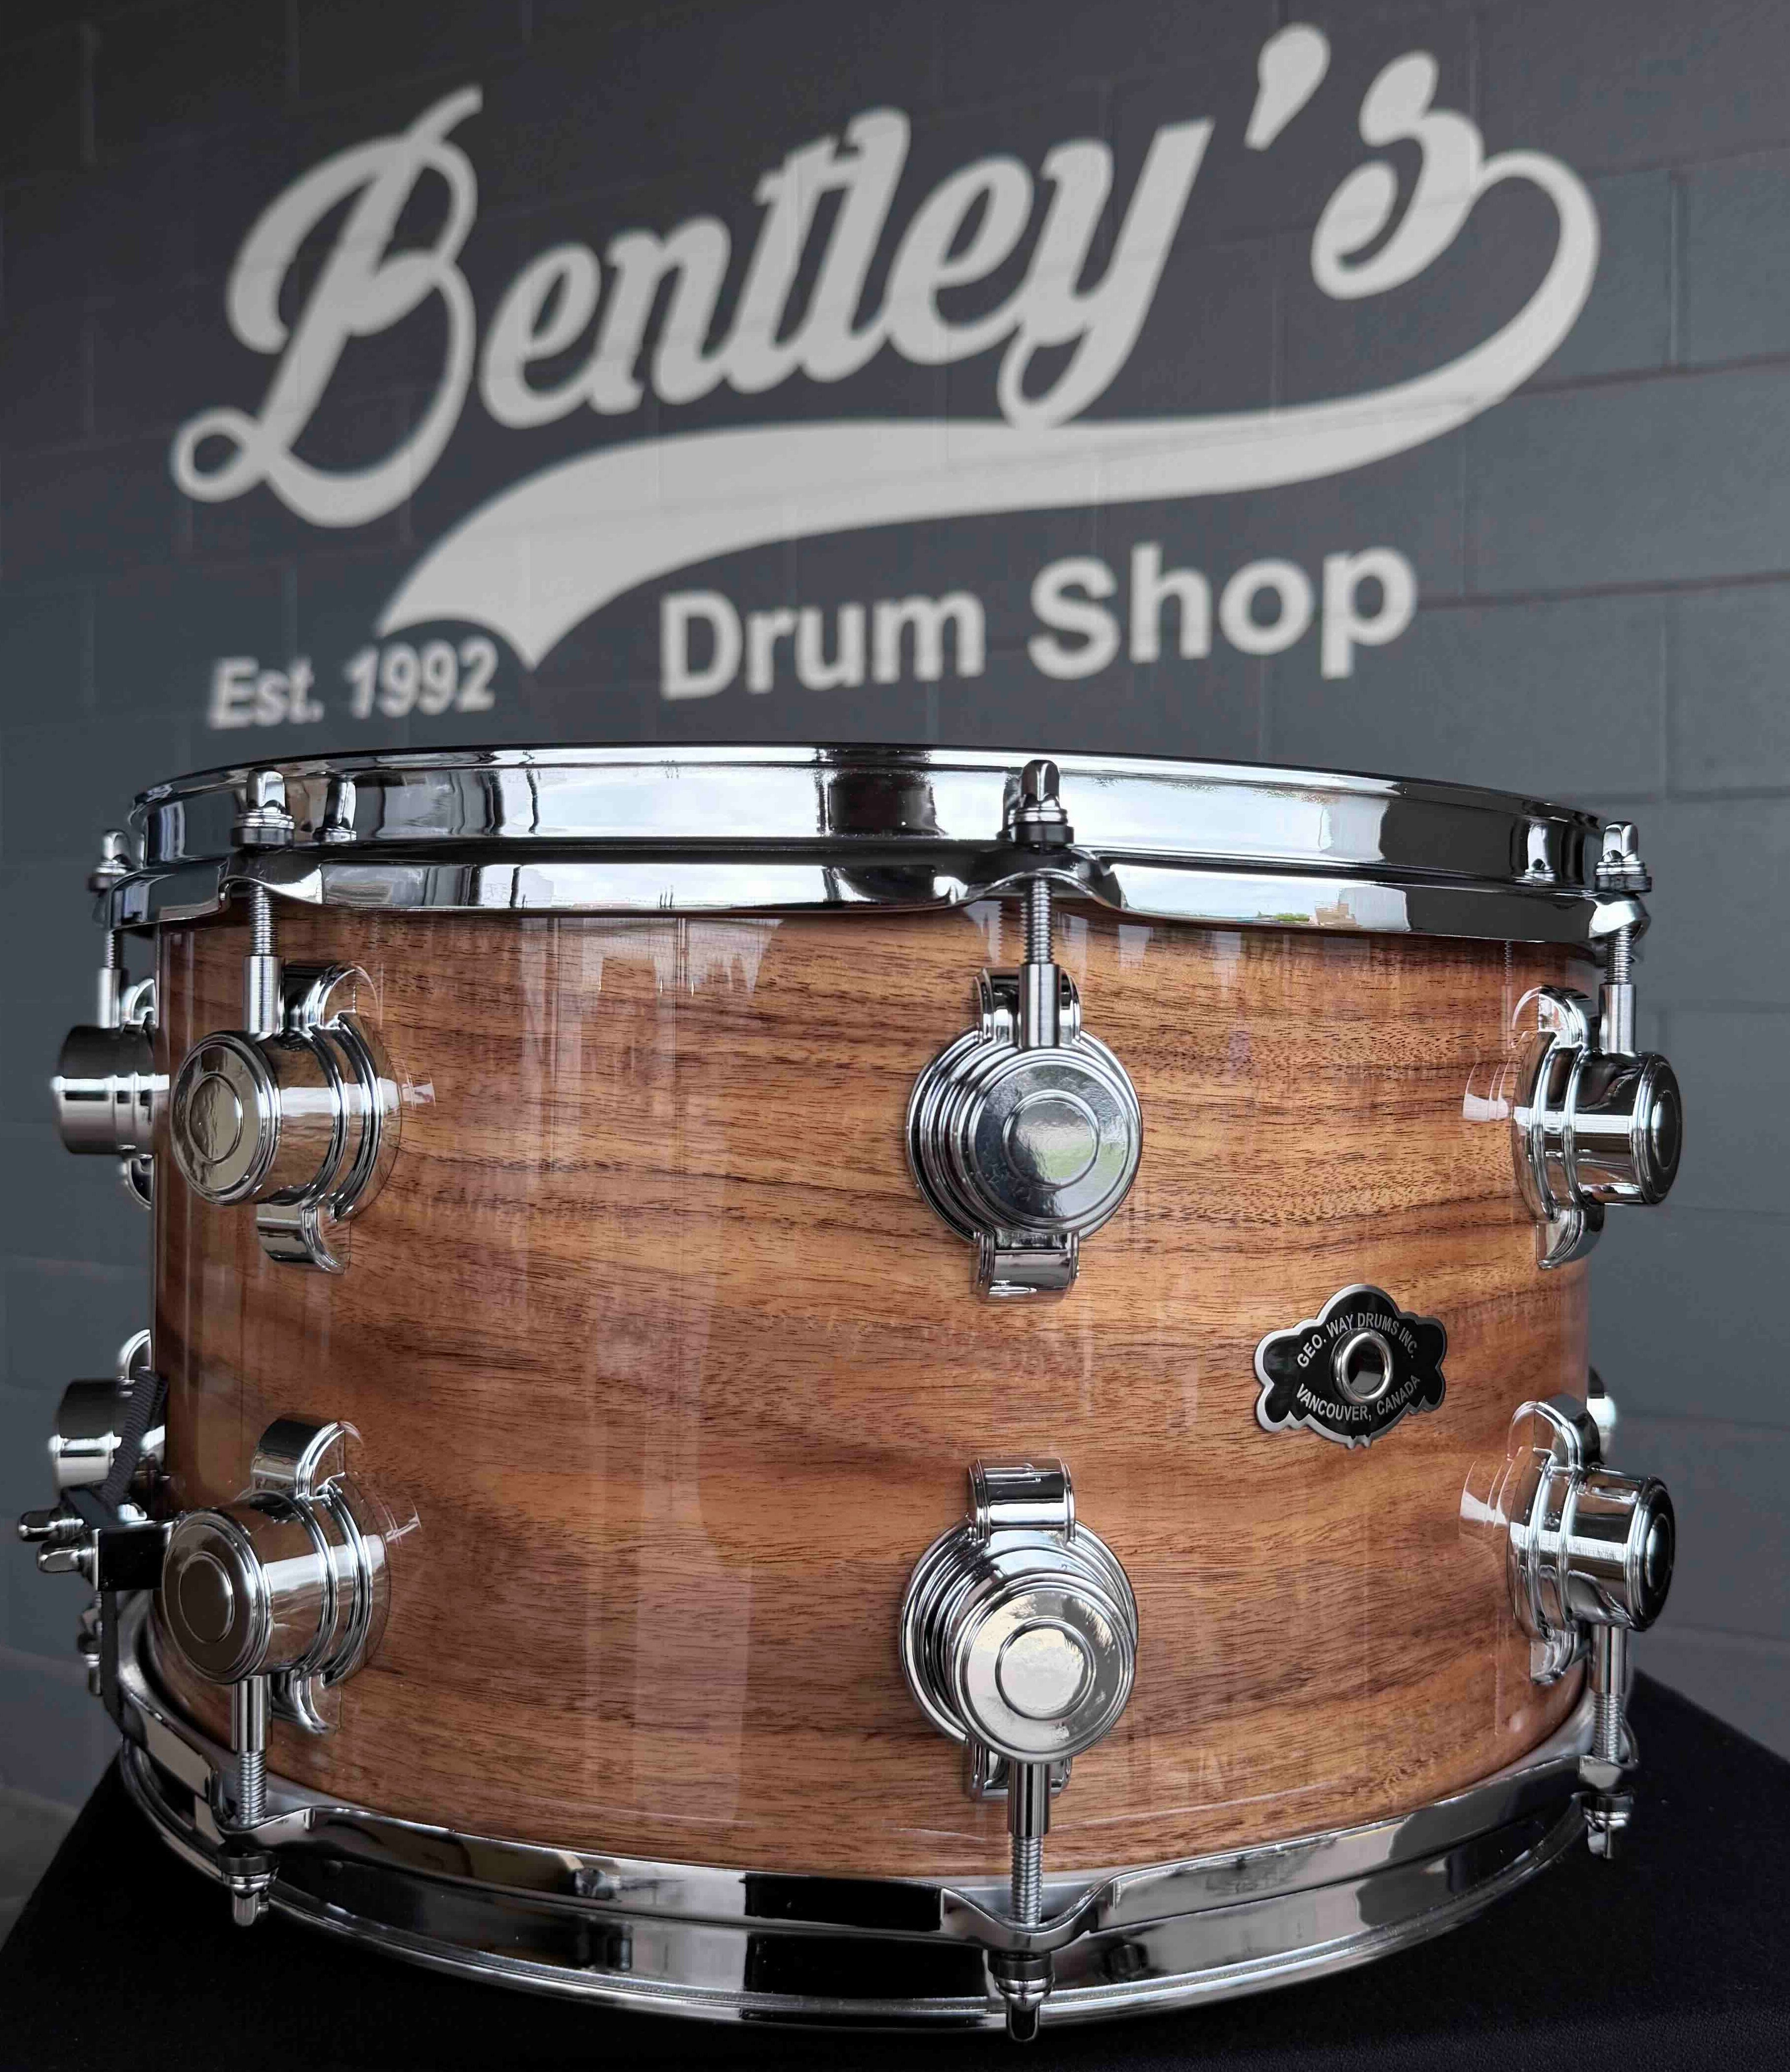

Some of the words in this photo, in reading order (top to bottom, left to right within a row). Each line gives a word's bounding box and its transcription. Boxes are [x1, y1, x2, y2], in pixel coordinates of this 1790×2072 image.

[171, 23, 1602, 528] Bentley's
[660, 589, 986, 701] Drum
[1027, 541, 1420, 681] Shop
[208, 657, 324, 729] Est.
[345, 637, 498, 719] 1992
[1296, 1333, 1327, 1368] GEO.
[1325, 1314, 1354, 1338] WAY
[1357, 1312, 1400, 1336] DRUMS
[1399, 1327, 1418, 1359] INC.
[1295, 1383, 1372, 1422] VANCOUVER,
[1376, 1374, 1421, 1416] CANADA
